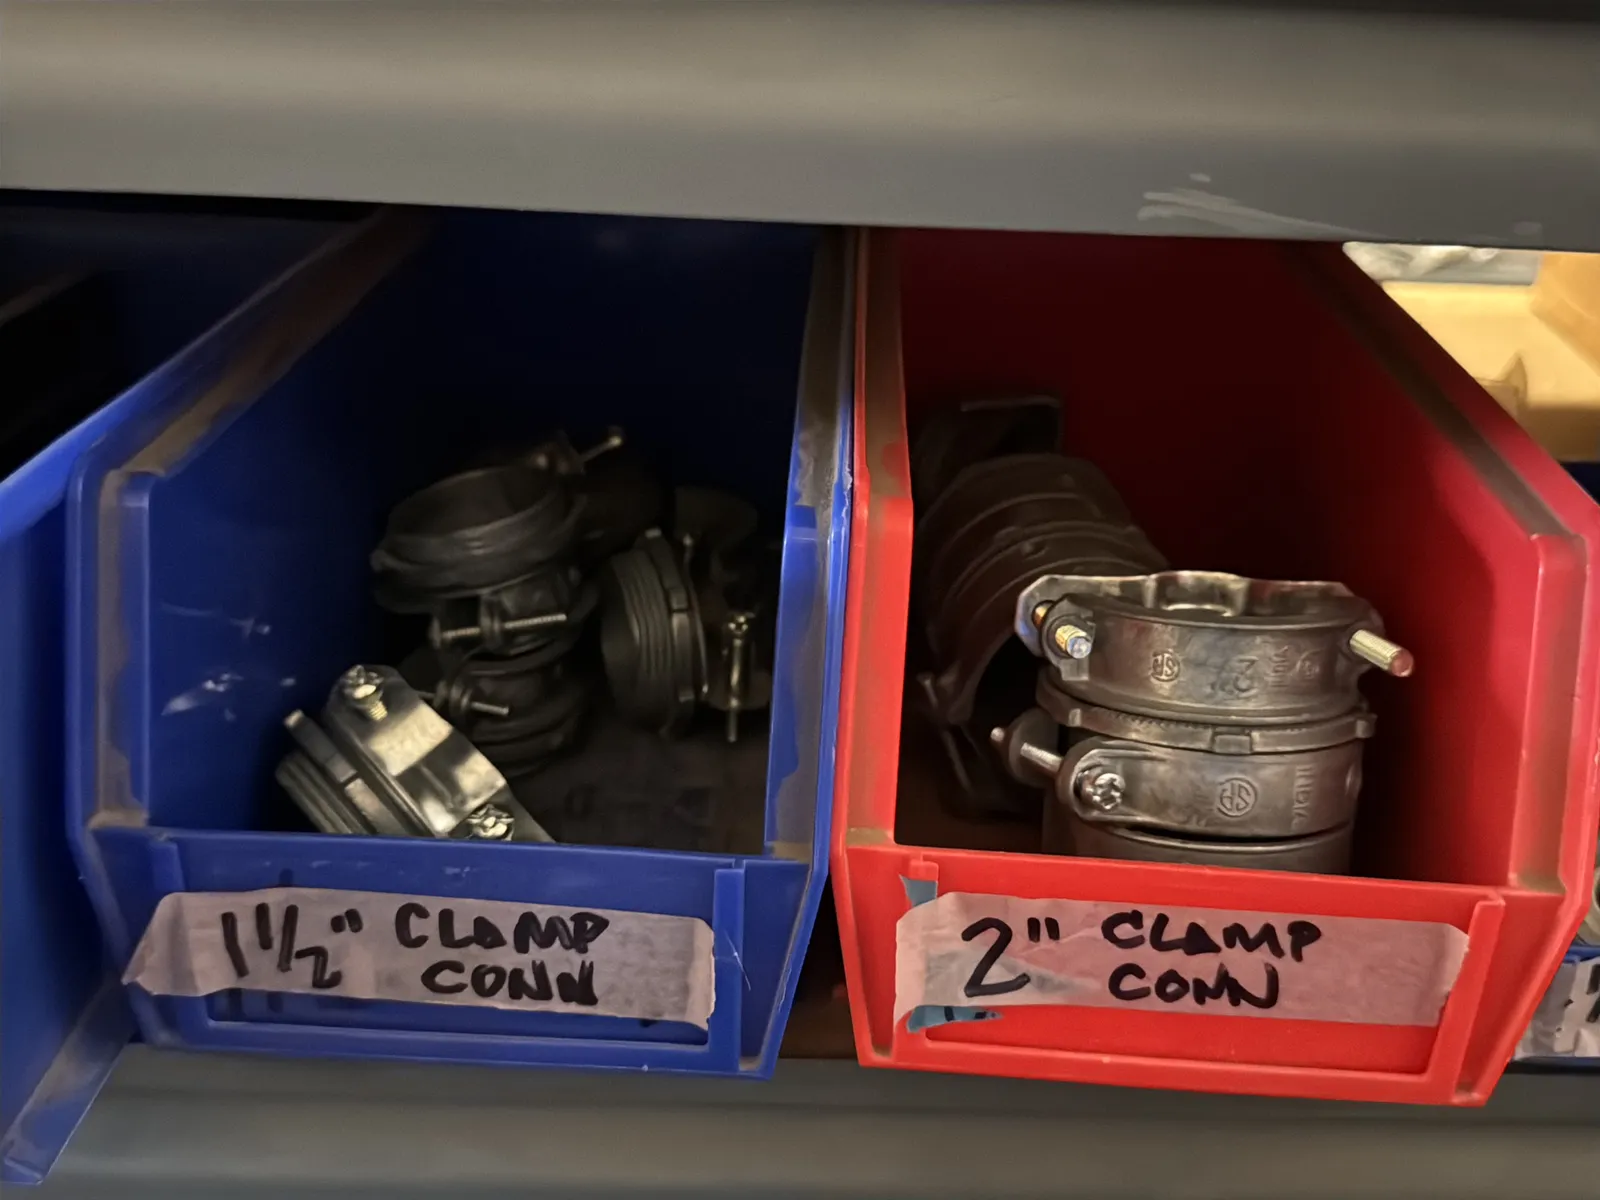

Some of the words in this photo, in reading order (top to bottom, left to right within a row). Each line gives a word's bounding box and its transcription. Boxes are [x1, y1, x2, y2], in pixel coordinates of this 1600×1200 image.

[395, 902, 610, 952] CLAMP
[961, 916, 1060, 998] 2"
[1100, 909, 1322, 962] CLAMP
[420, 958, 600, 1006] CONN
[1107, 962, 1280, 1009] CONN
